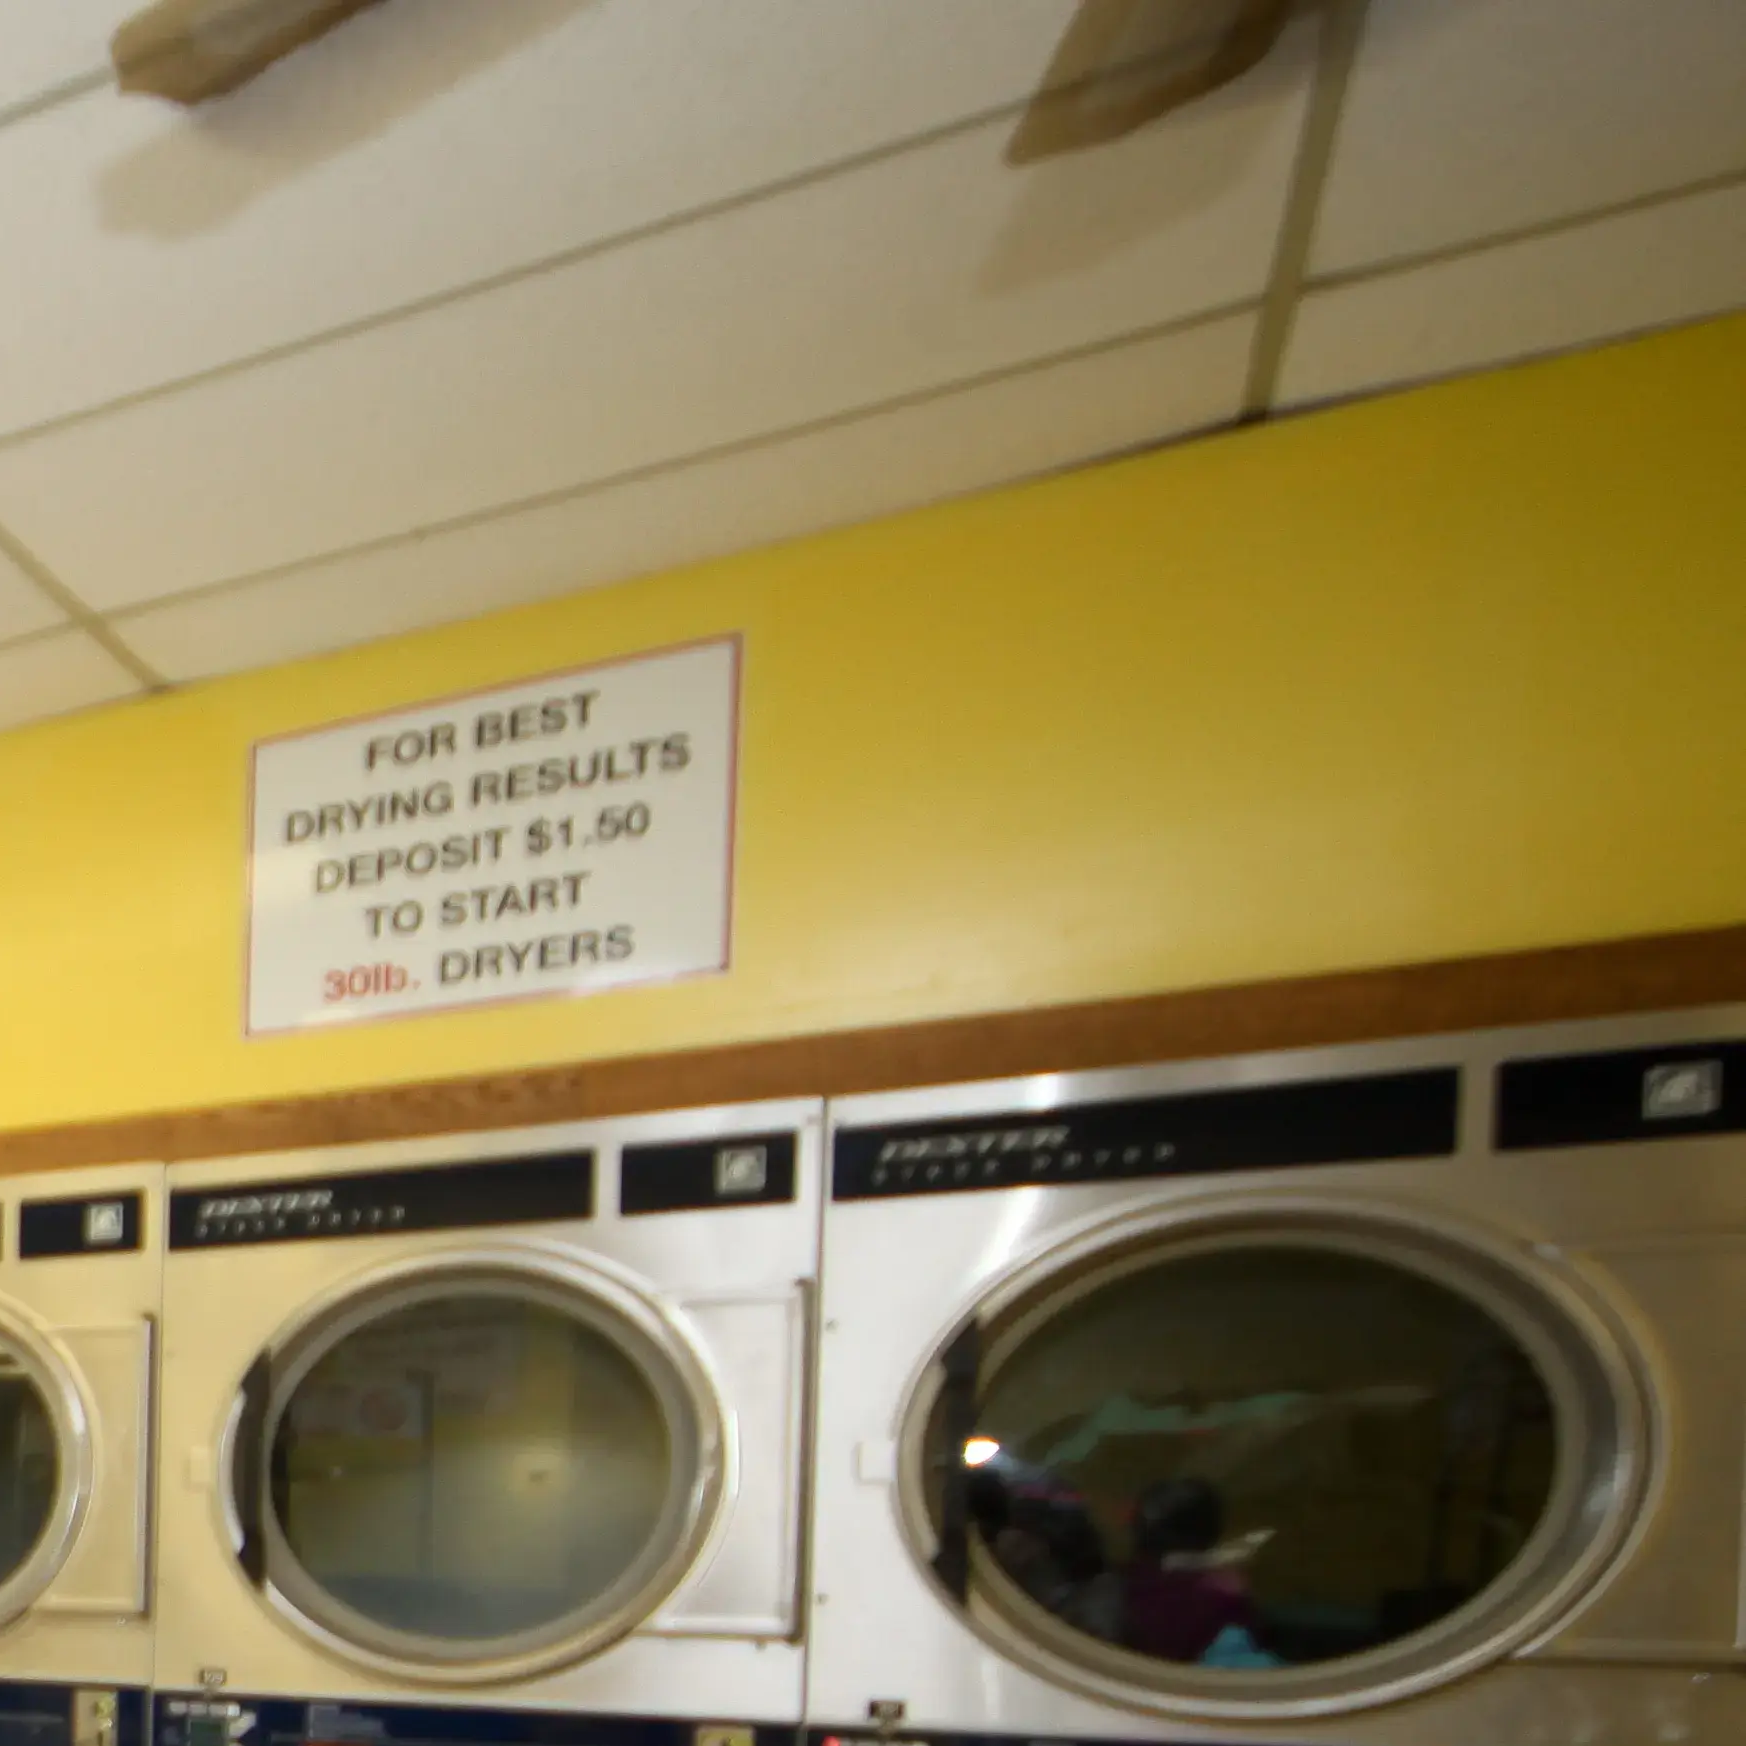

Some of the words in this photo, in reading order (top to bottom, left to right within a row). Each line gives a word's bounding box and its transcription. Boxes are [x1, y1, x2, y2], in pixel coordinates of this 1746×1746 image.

[363, 721, 456, 771] FOR
[473, 689, 600, 747] BEST
[285, 782, 453, 845] DRYING
[470, 732, 691, 806] RESULTS
[314, 826, 511, 893] DEPOSIT
[526, 802, 651, 854] $1.50
[365, 900, 423, 938] TO
[439, 870, 592, 927] START
[323, 961, 421, 1001] 30lb.
[438, 925, 635, 985] DRYERS
